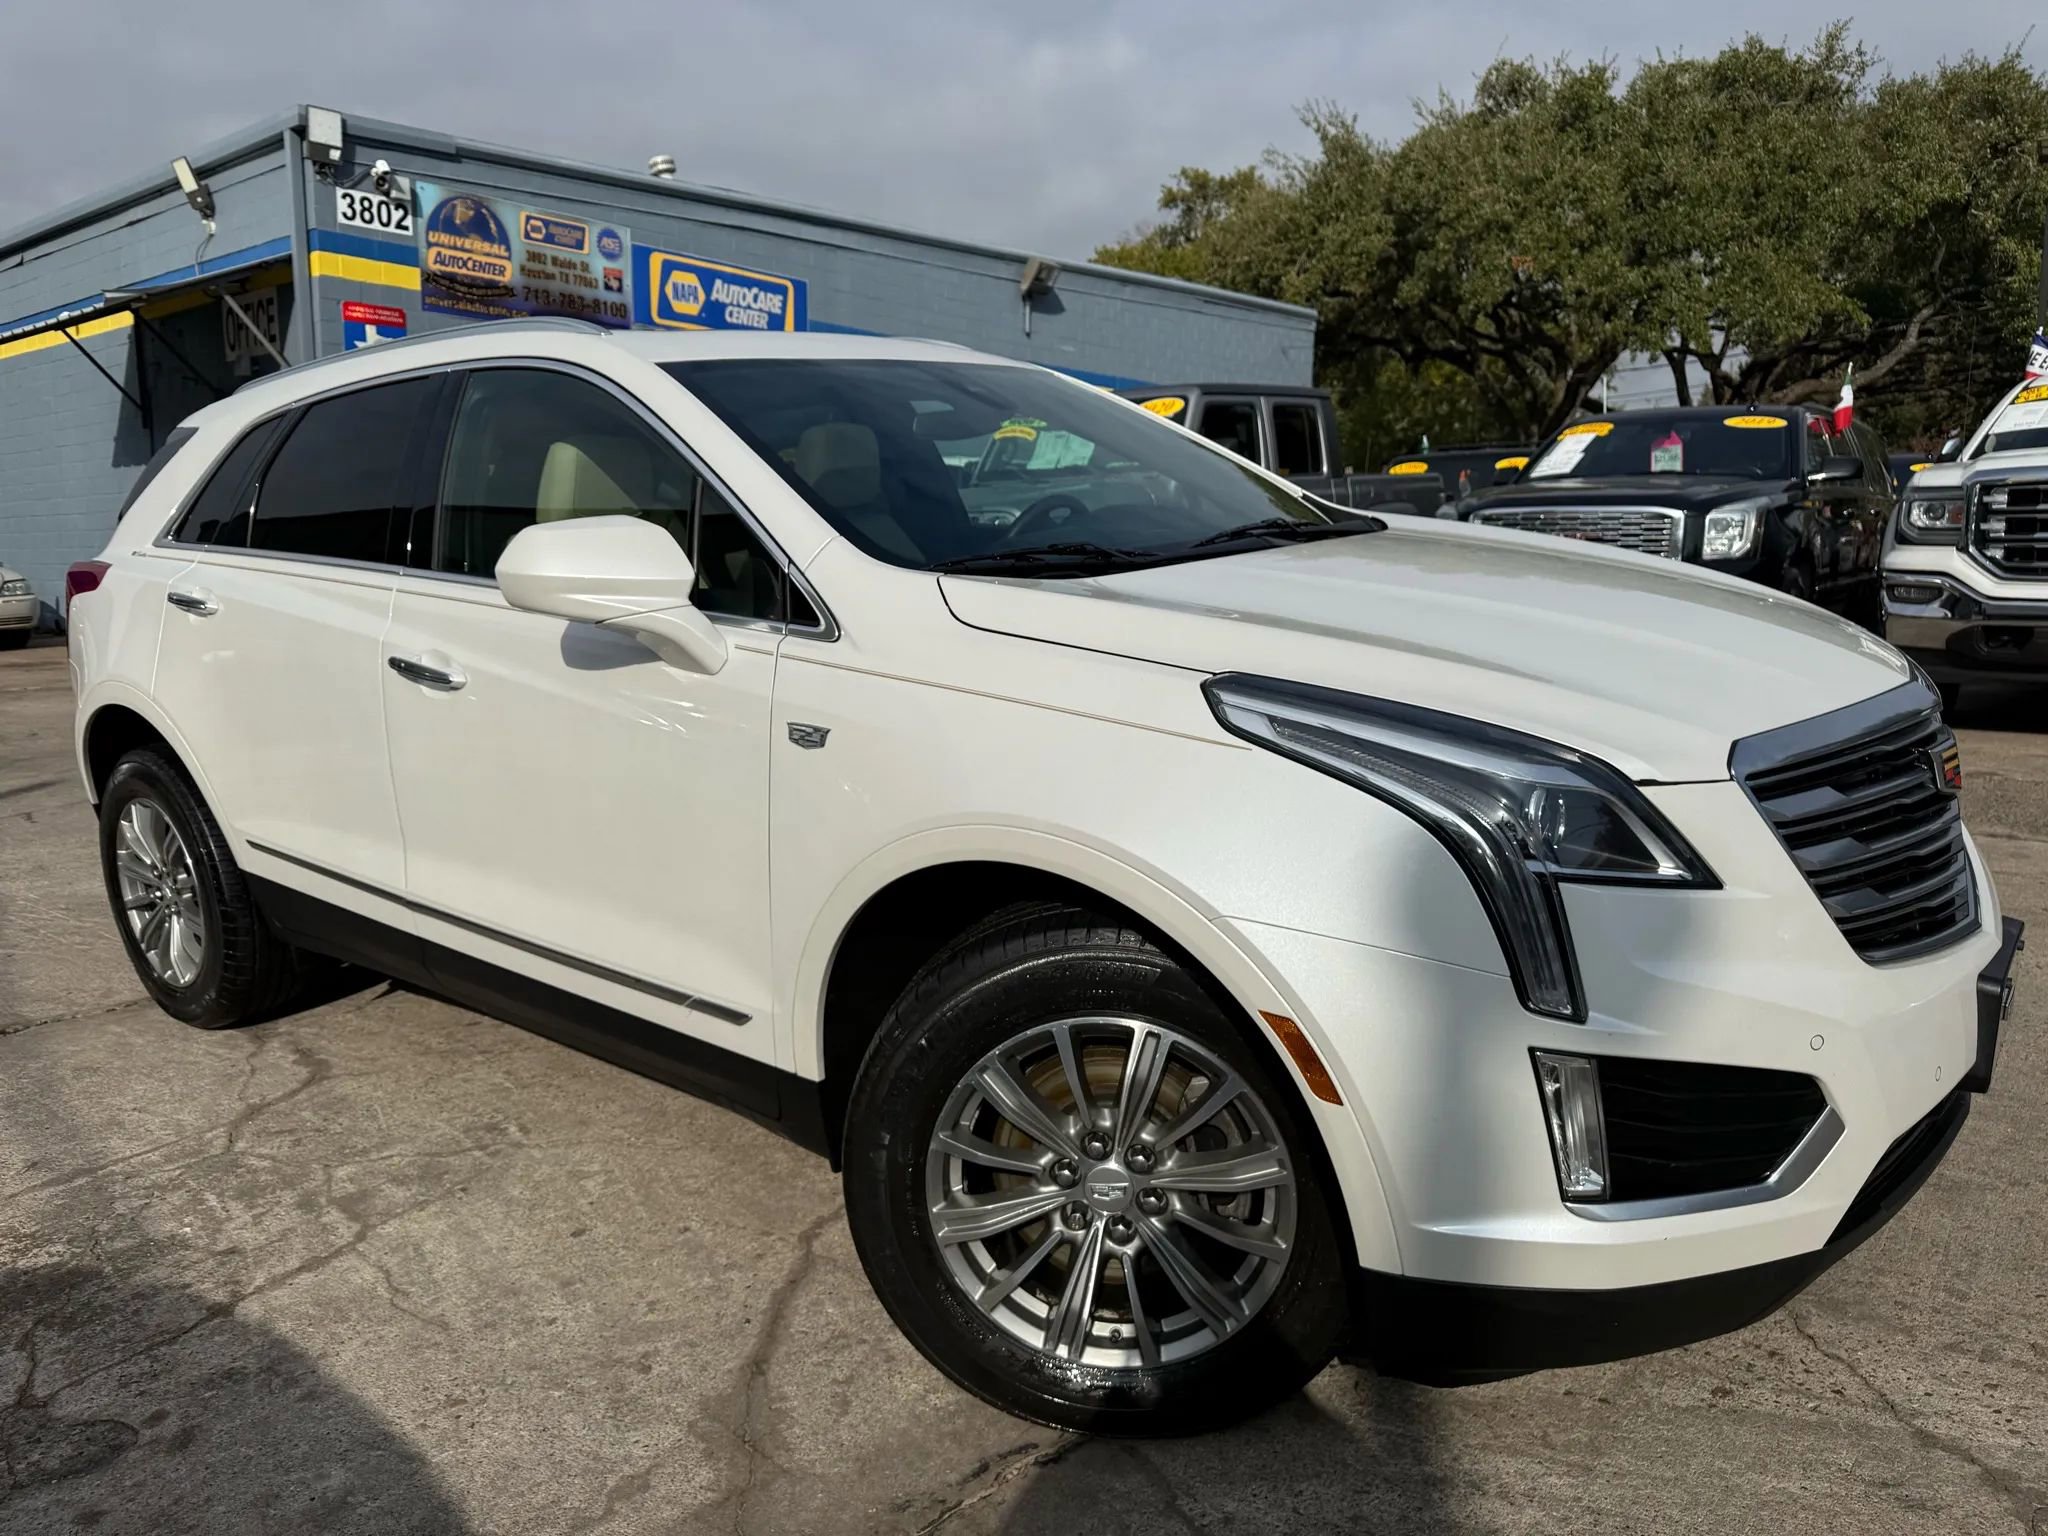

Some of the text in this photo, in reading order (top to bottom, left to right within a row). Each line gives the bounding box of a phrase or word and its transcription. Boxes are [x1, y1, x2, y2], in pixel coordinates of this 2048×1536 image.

[341, 192, 410, 231] 3802
[427, 230, 510, 256] UNIVERSAL
[432, 250, 507, 277] AUTOCENTER
[672, 280, 699, 305] NAPA
[711, 278, 783, 314] AUTOCARE
[225, 297, 277, 352] OFFICE
[725, 305, 768, 329] CENTER
